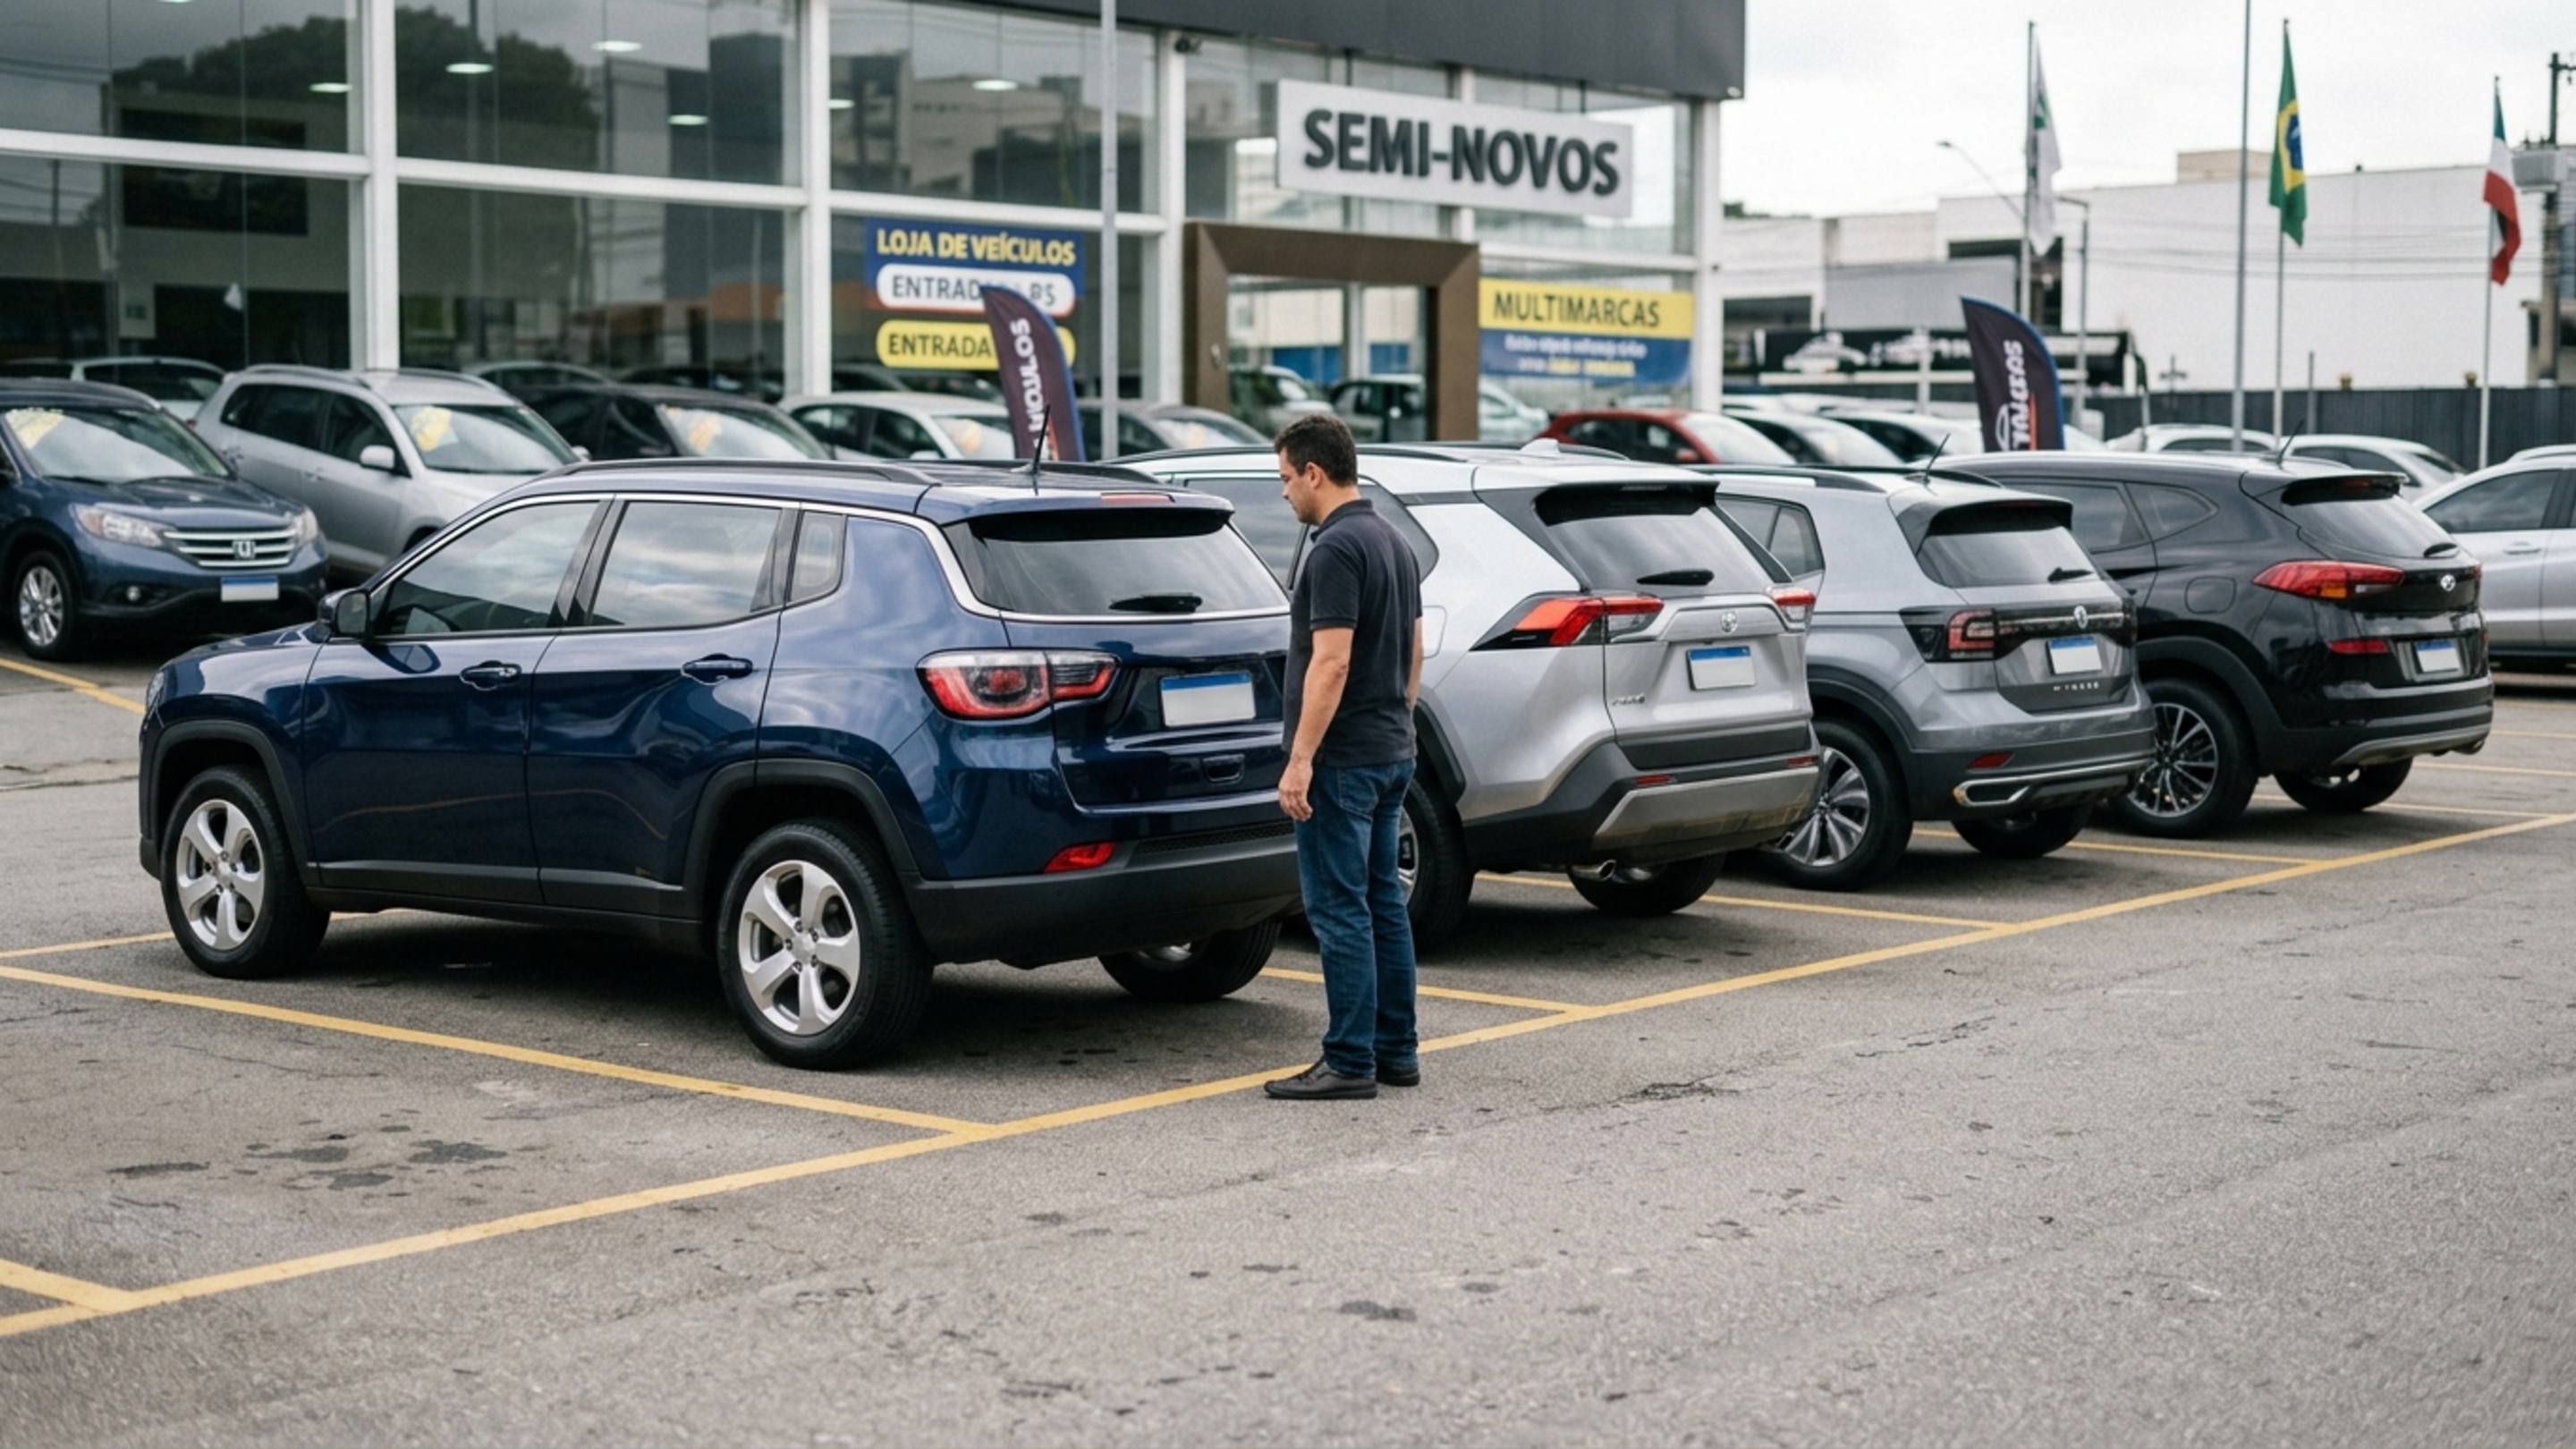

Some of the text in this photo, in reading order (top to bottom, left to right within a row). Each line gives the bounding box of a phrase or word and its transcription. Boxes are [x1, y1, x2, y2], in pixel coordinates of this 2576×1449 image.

[1303, 108, 1621, 197] SEMI-NOVOS
[877, 228, 1077, 267] LOJA DE VEÍCULOS
[892, 275, 985, 302] ENTRAD
[1493, 291, 1661, 328] MULTIMARCAS
[887, 333, 993, 360] ENTRADA
